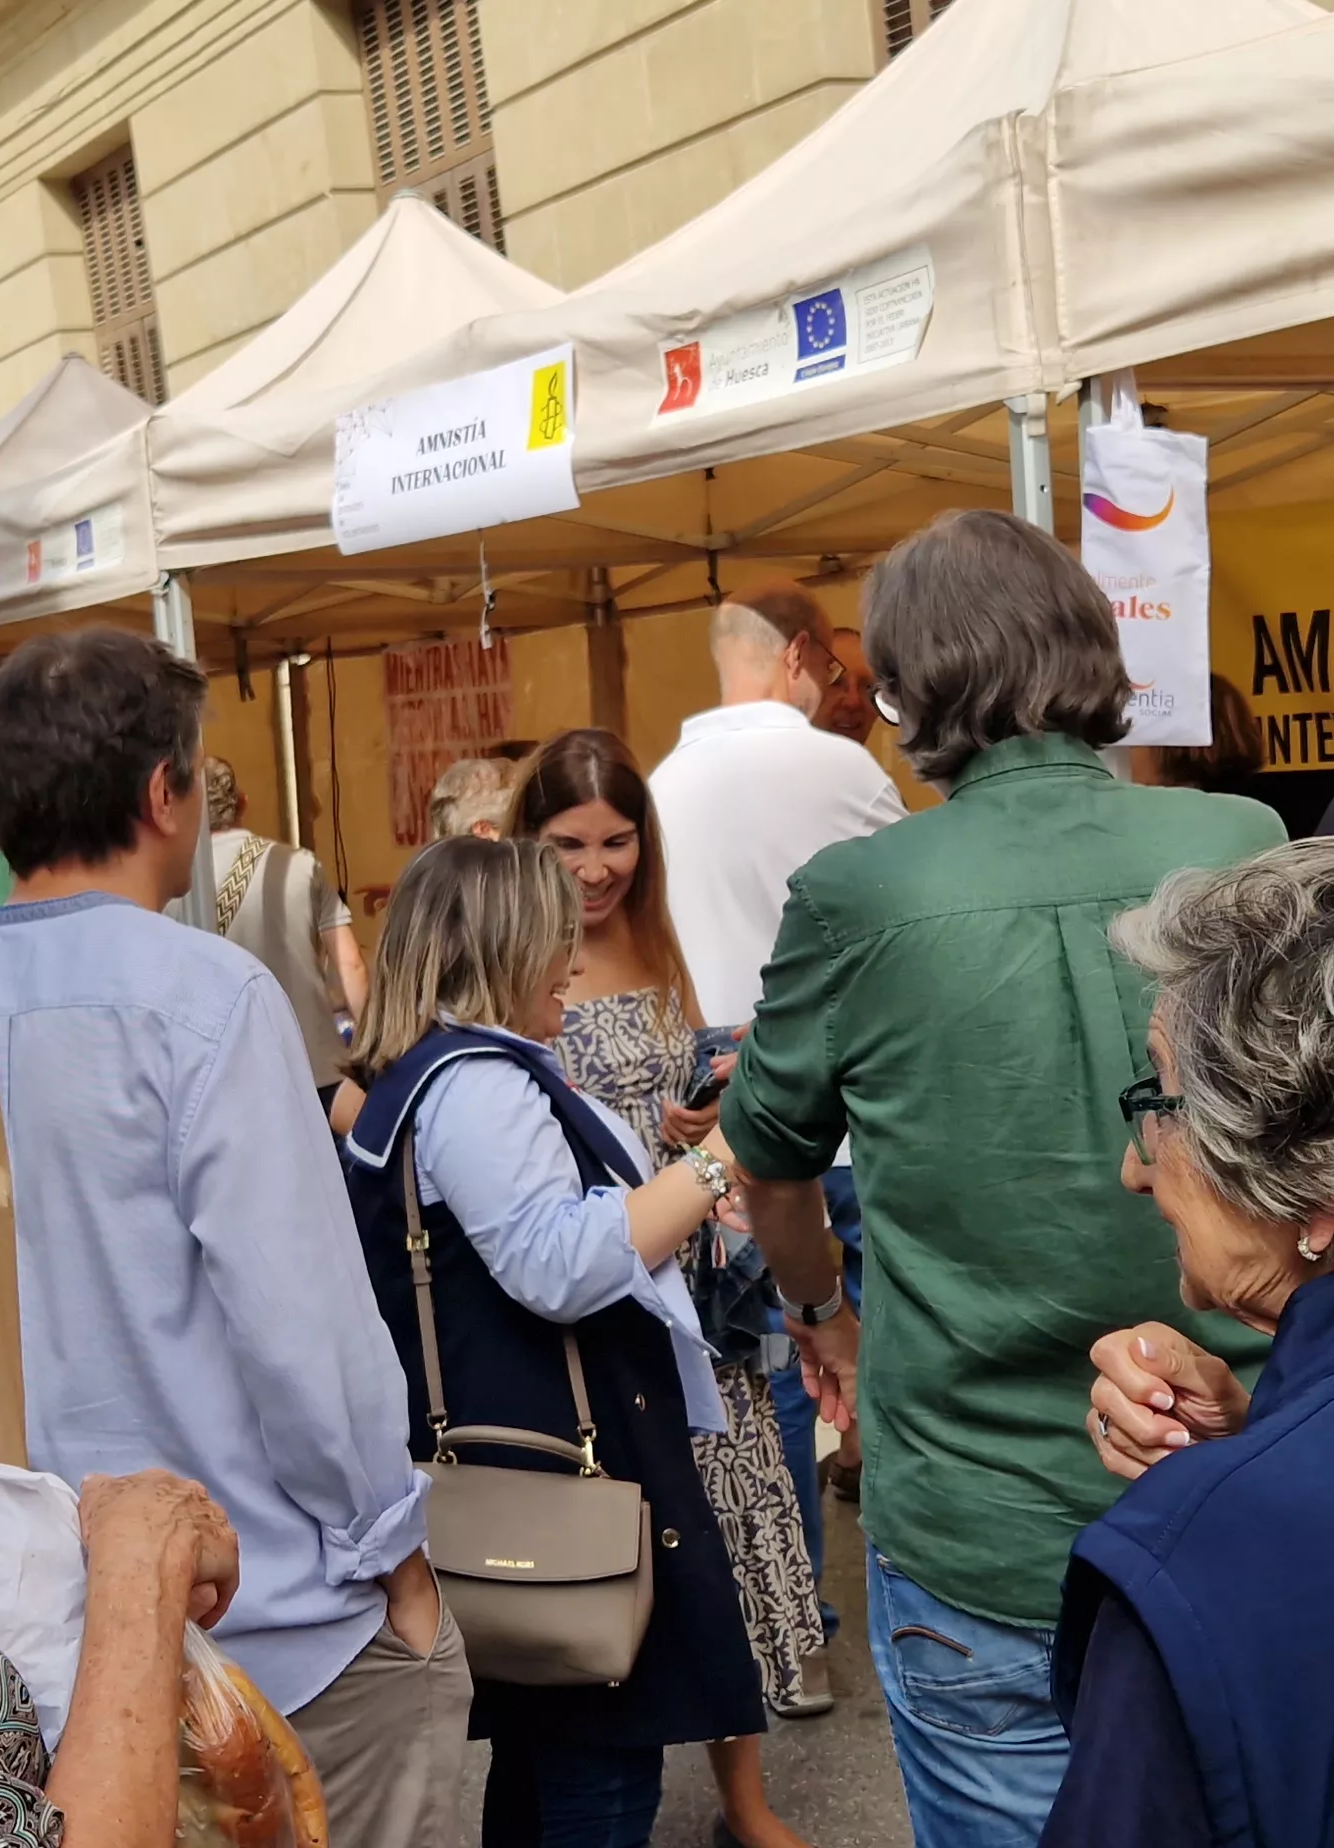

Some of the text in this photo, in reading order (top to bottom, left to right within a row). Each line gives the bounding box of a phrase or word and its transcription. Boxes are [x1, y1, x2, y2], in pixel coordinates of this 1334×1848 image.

[709, 331, 789, 374] Ayuntamiento
[724, 361, 769, 388] Huesca
[416, 415, 487, 456] AMNISTÍA
[390, 449, 508, 495] INTERNACIONAL
[1093, 570, 1157, 590] lmente
